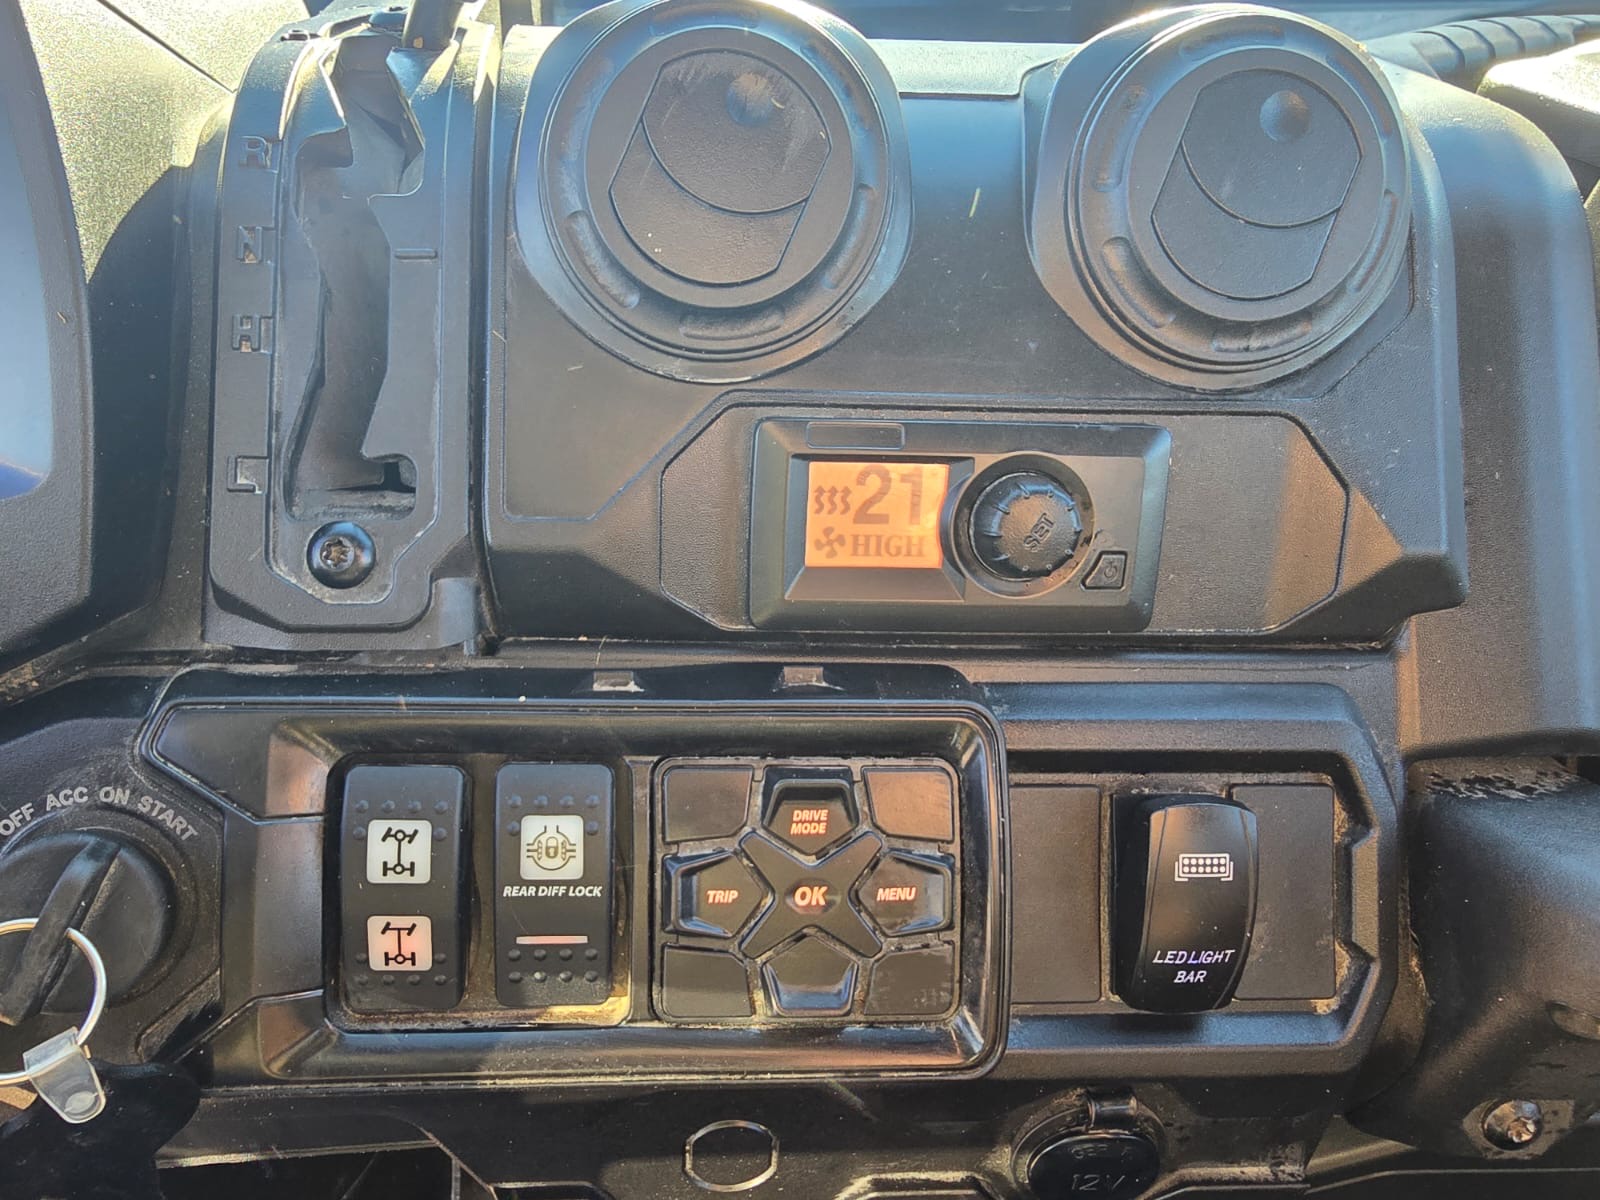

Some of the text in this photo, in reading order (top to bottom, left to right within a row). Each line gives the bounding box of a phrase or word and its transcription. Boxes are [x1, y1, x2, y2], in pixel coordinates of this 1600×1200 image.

[852, 464, 924, 526] 21
[1022, 512, 1057, 551] SET
[850, 534, 925, 558] HIGH
[0, 786, 198, 841] OFF ACC ON START
[792, 809, 828, 822] DRIVE
[790, 822, 827, 835] MODE
[503, 885, 602, 897] REAR DIFF LOCK
[706, 890, 738, 904] TRIP
[794, 886, 828, 906] OK
[876, 887, 916, 901] MENU
[1152, 949, 1235, 964] LED LIGHT
[1174, 970, 1207, 983] BAR
[1071, 1173, 1127, 1192] 12V
